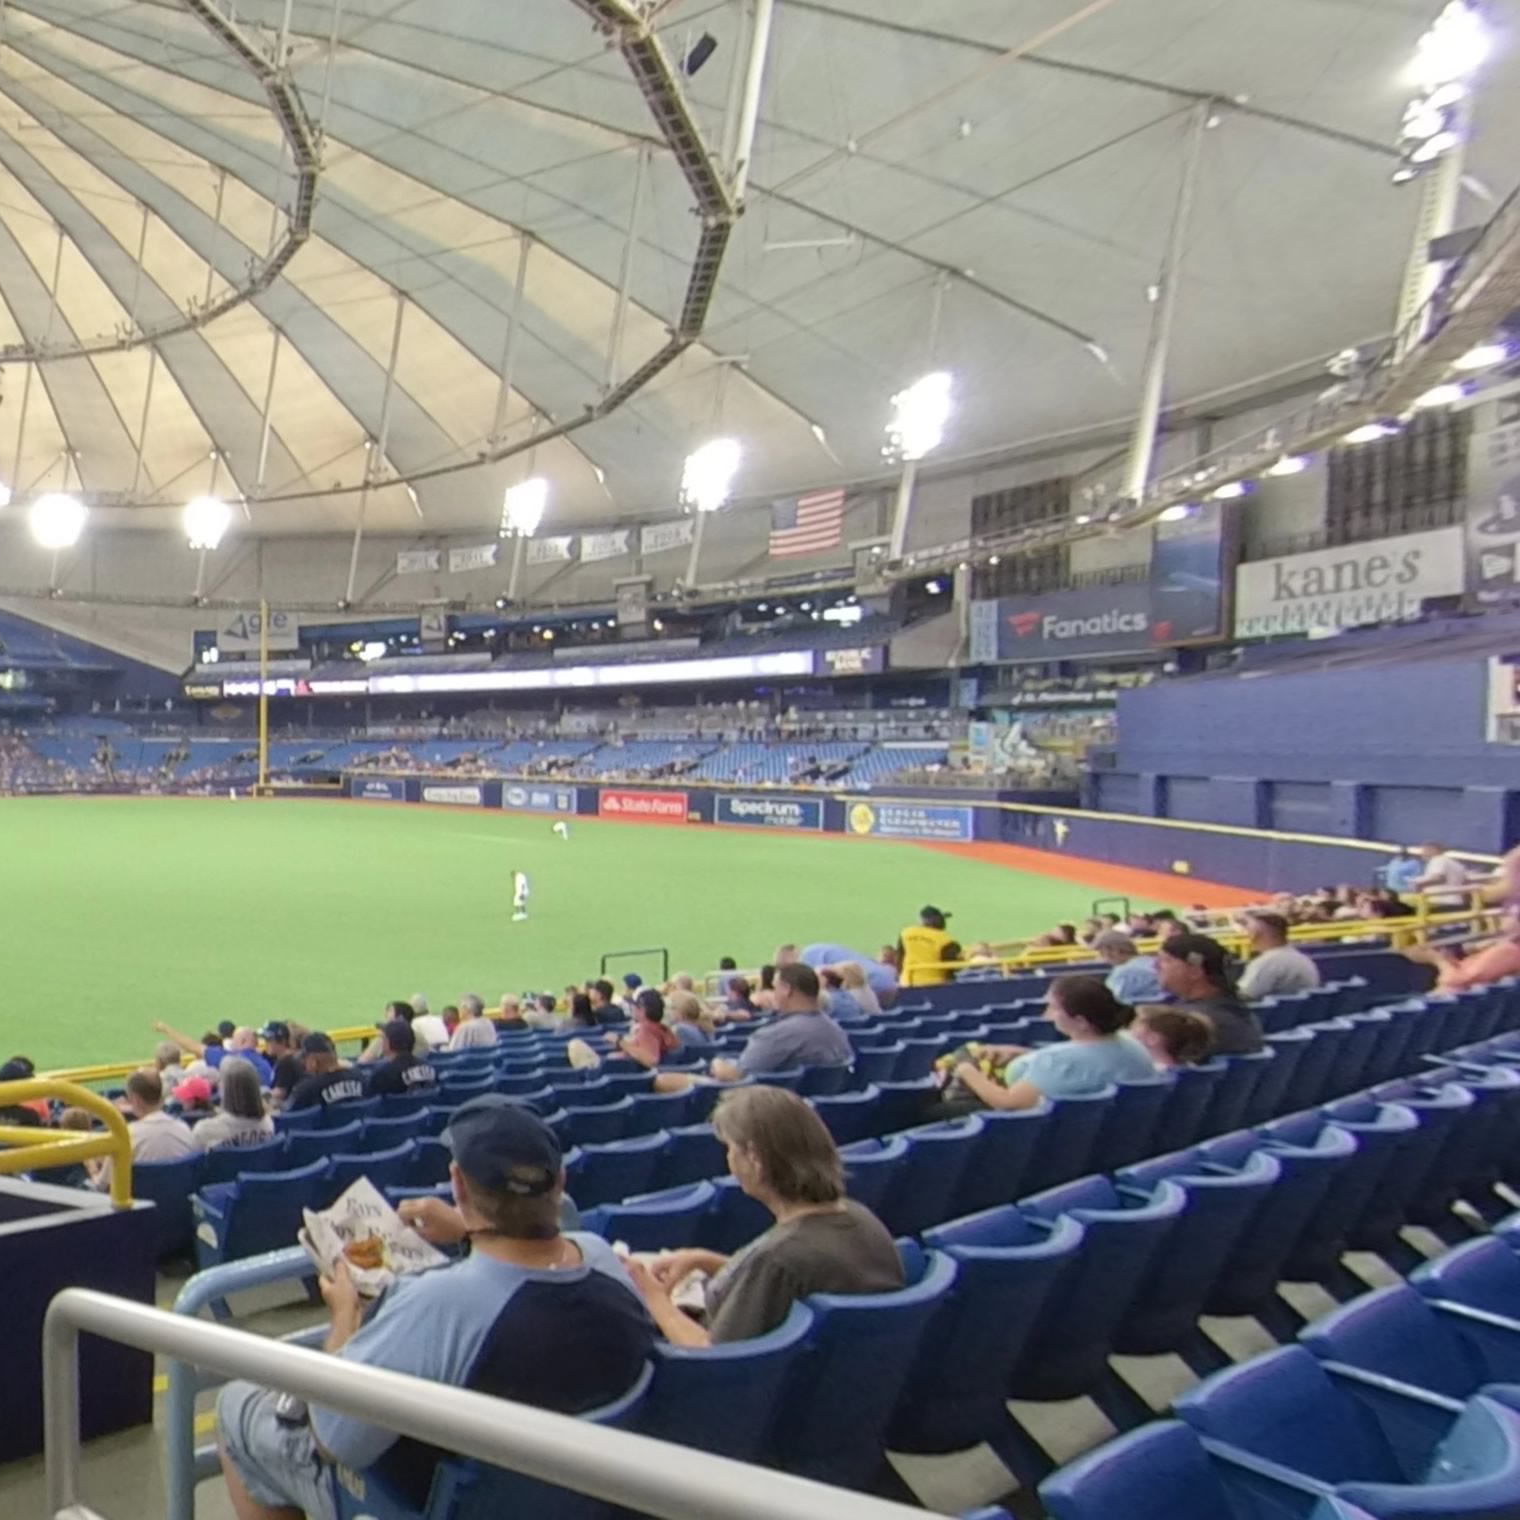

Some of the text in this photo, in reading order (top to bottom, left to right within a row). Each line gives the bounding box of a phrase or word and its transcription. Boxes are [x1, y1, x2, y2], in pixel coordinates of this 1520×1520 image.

[1042, 609, 1149, 640] Fanatics
[621, 799, 682, 815] State Farm
[730, 799, 800, 816] Spectrum
